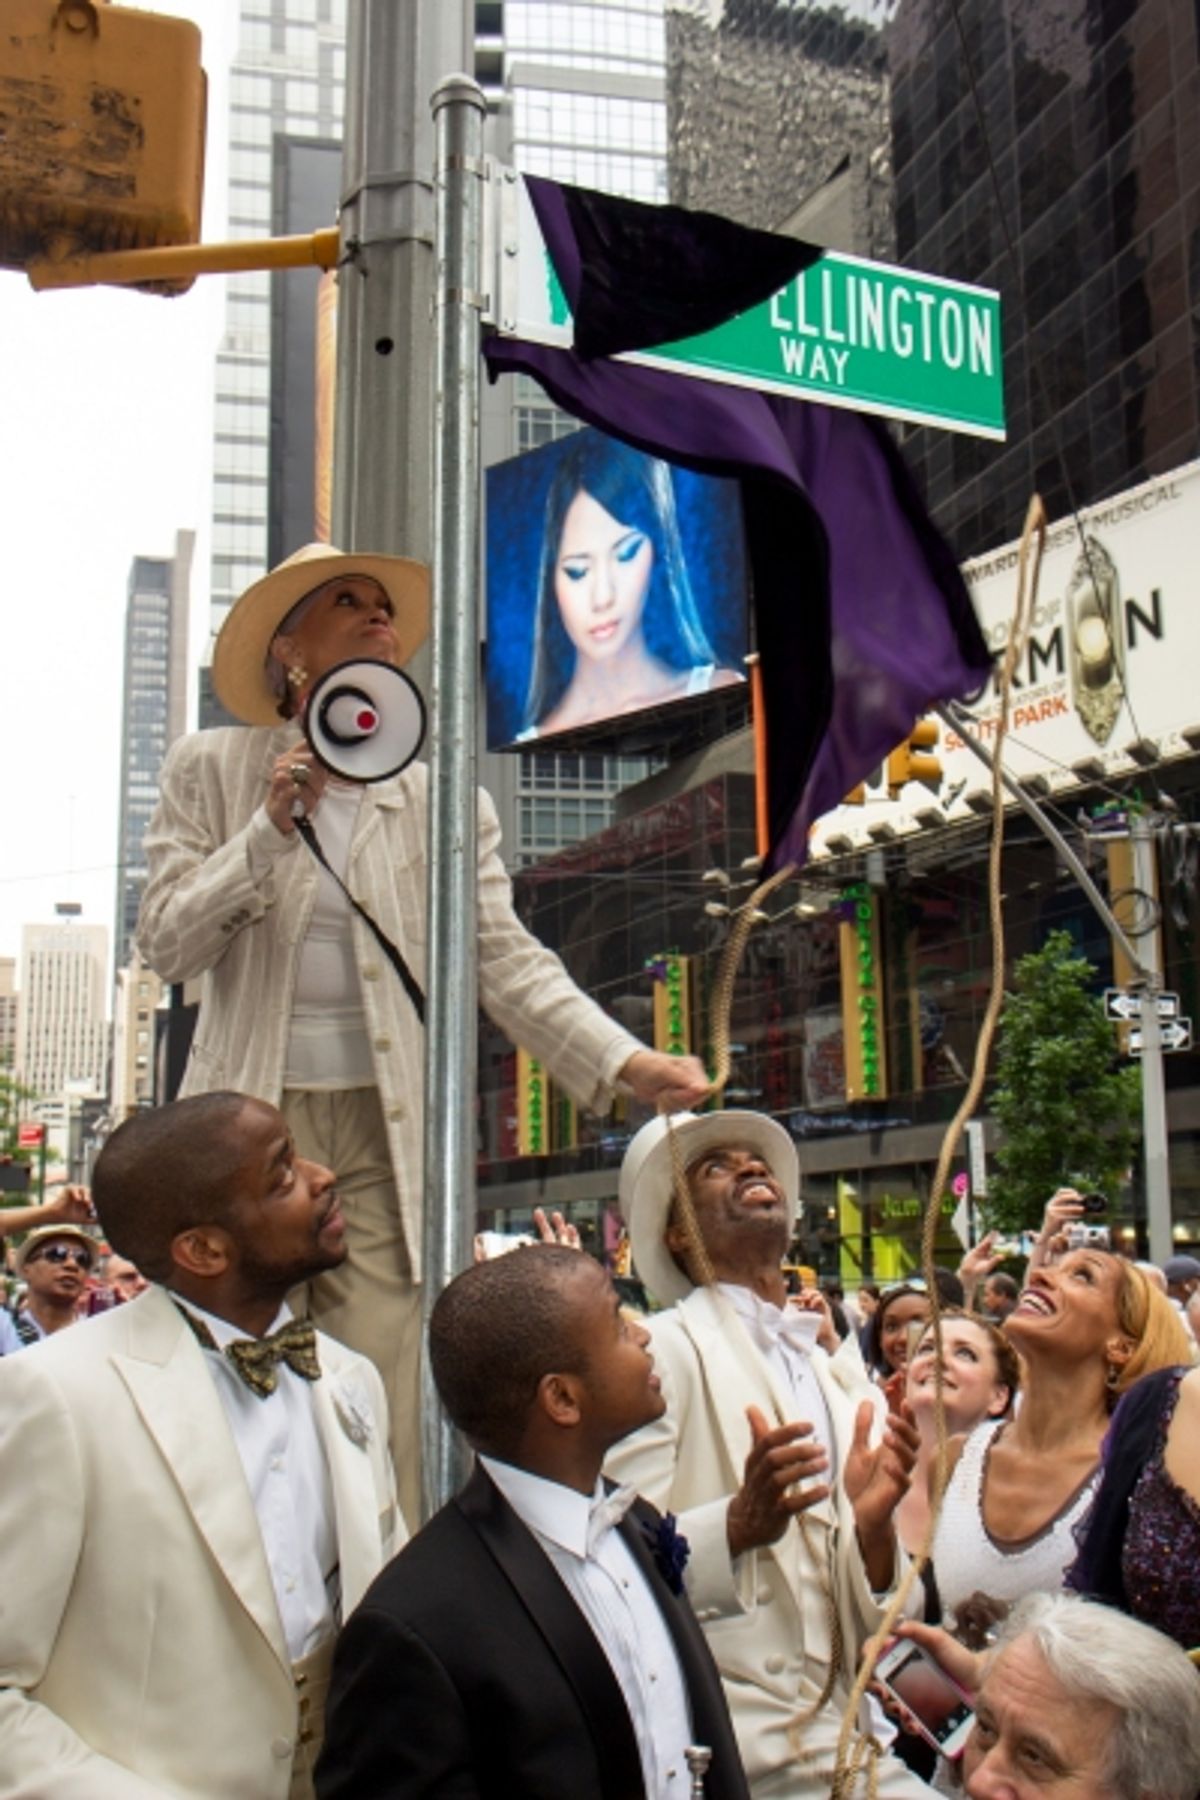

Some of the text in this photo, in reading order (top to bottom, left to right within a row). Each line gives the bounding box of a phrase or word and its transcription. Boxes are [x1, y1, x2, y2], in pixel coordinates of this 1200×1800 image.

[770, 270, 994, 376] ELLINGTON
[779, 336, 850, 385] WAY
[1092, 483, 1181, 531] MUSICAL
[1013, 694, 1068, 730] PARK
